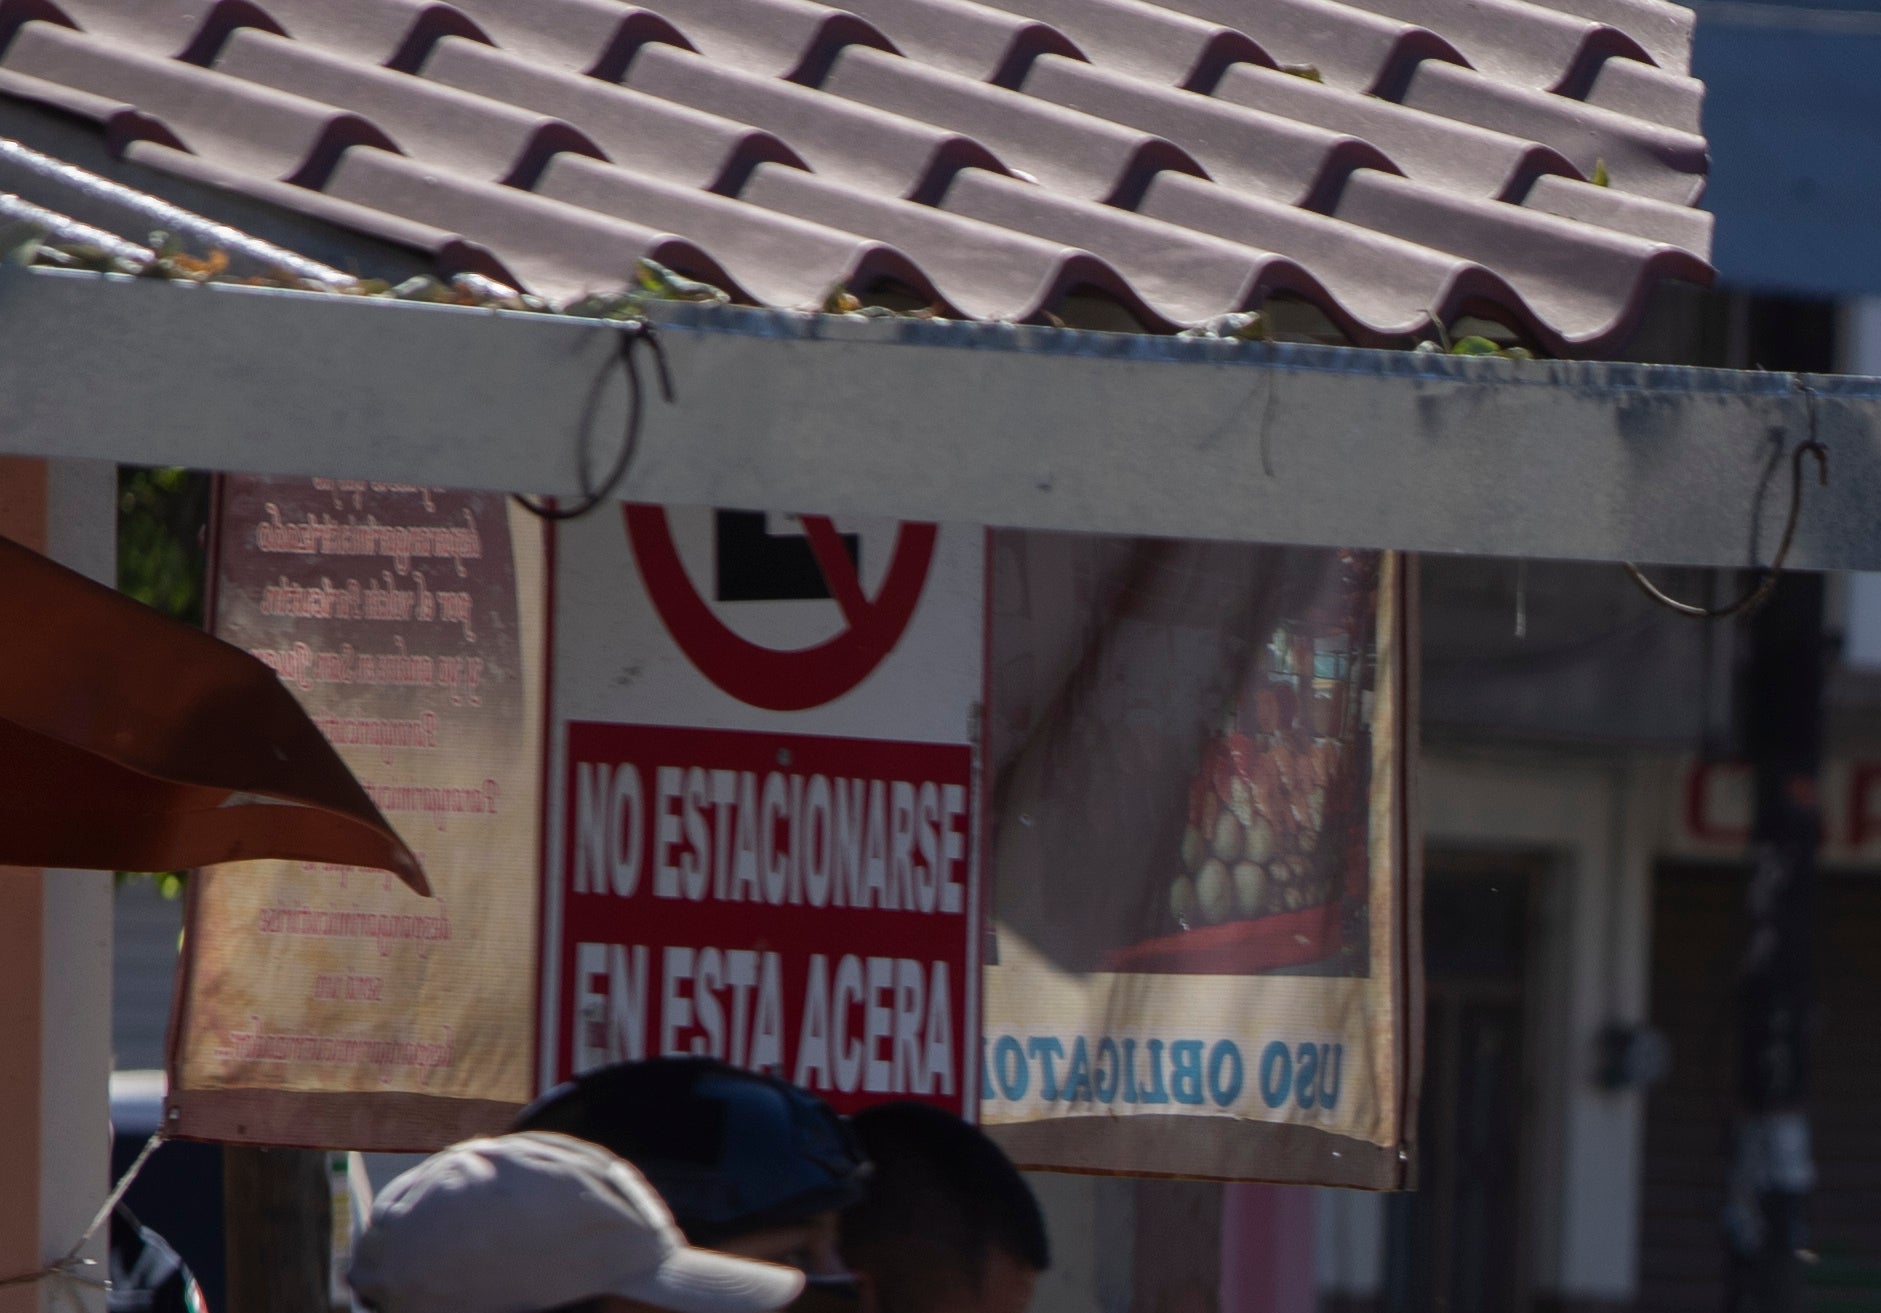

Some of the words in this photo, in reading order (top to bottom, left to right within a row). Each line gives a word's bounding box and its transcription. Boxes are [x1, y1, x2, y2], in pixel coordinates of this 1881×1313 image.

[573, 762, 645, 899] NO
[653, 768, 966, 916] ESTACIONARSE
[575, 941, 648, 1068] EN
[660, 947, 785, 1080] ESTA
[796, 955, 954, 1095] ACERA
